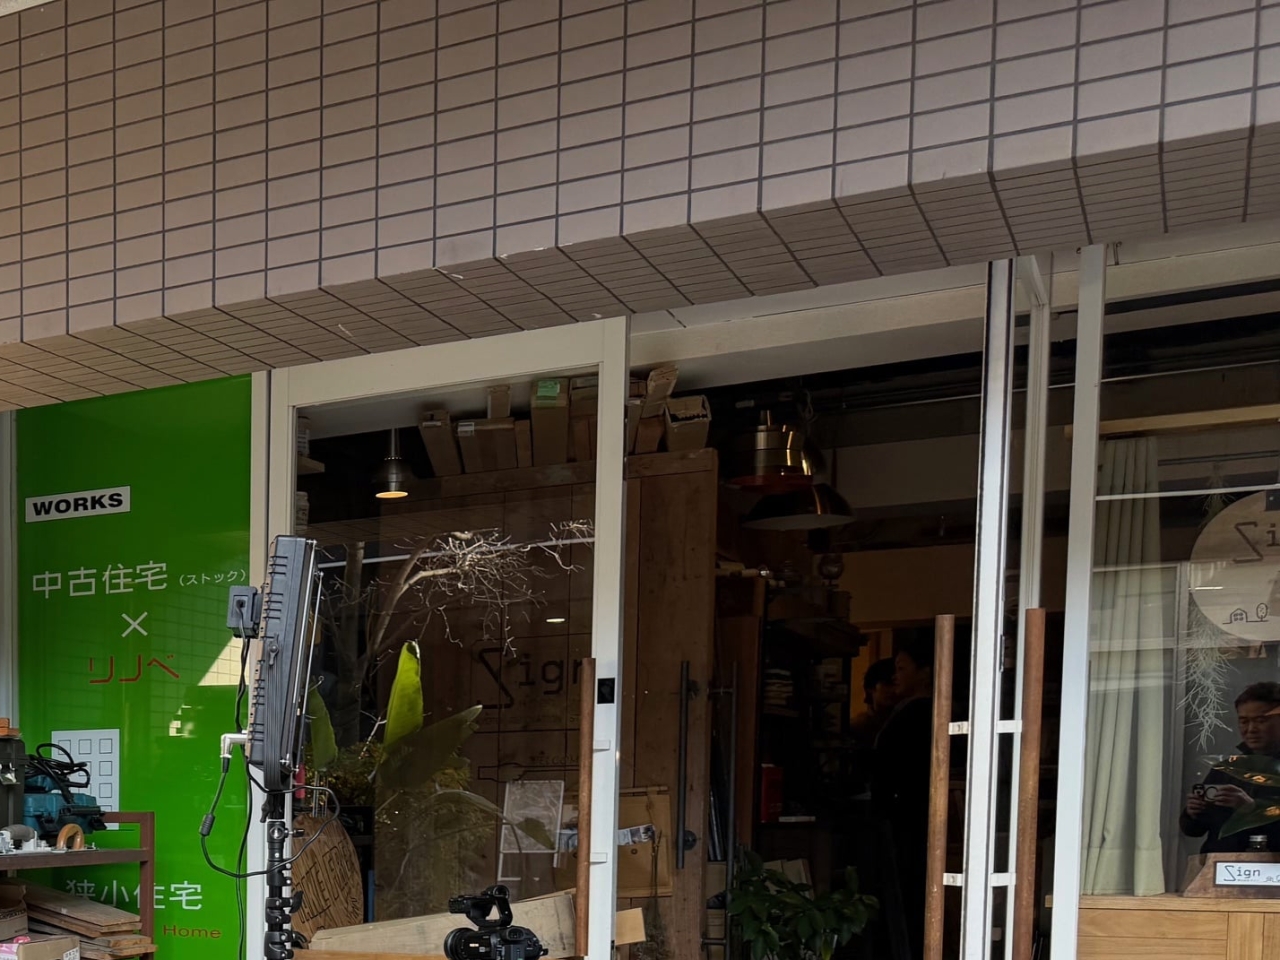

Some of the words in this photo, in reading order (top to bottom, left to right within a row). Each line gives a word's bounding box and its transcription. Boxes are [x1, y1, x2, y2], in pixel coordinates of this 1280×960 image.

[32, 492, 124, 516] WORKS
[32, 560, 168, 599] 中古住宅
[1223, 864, 1261, 882] Sign
[163, 924, 222, 939] Home
